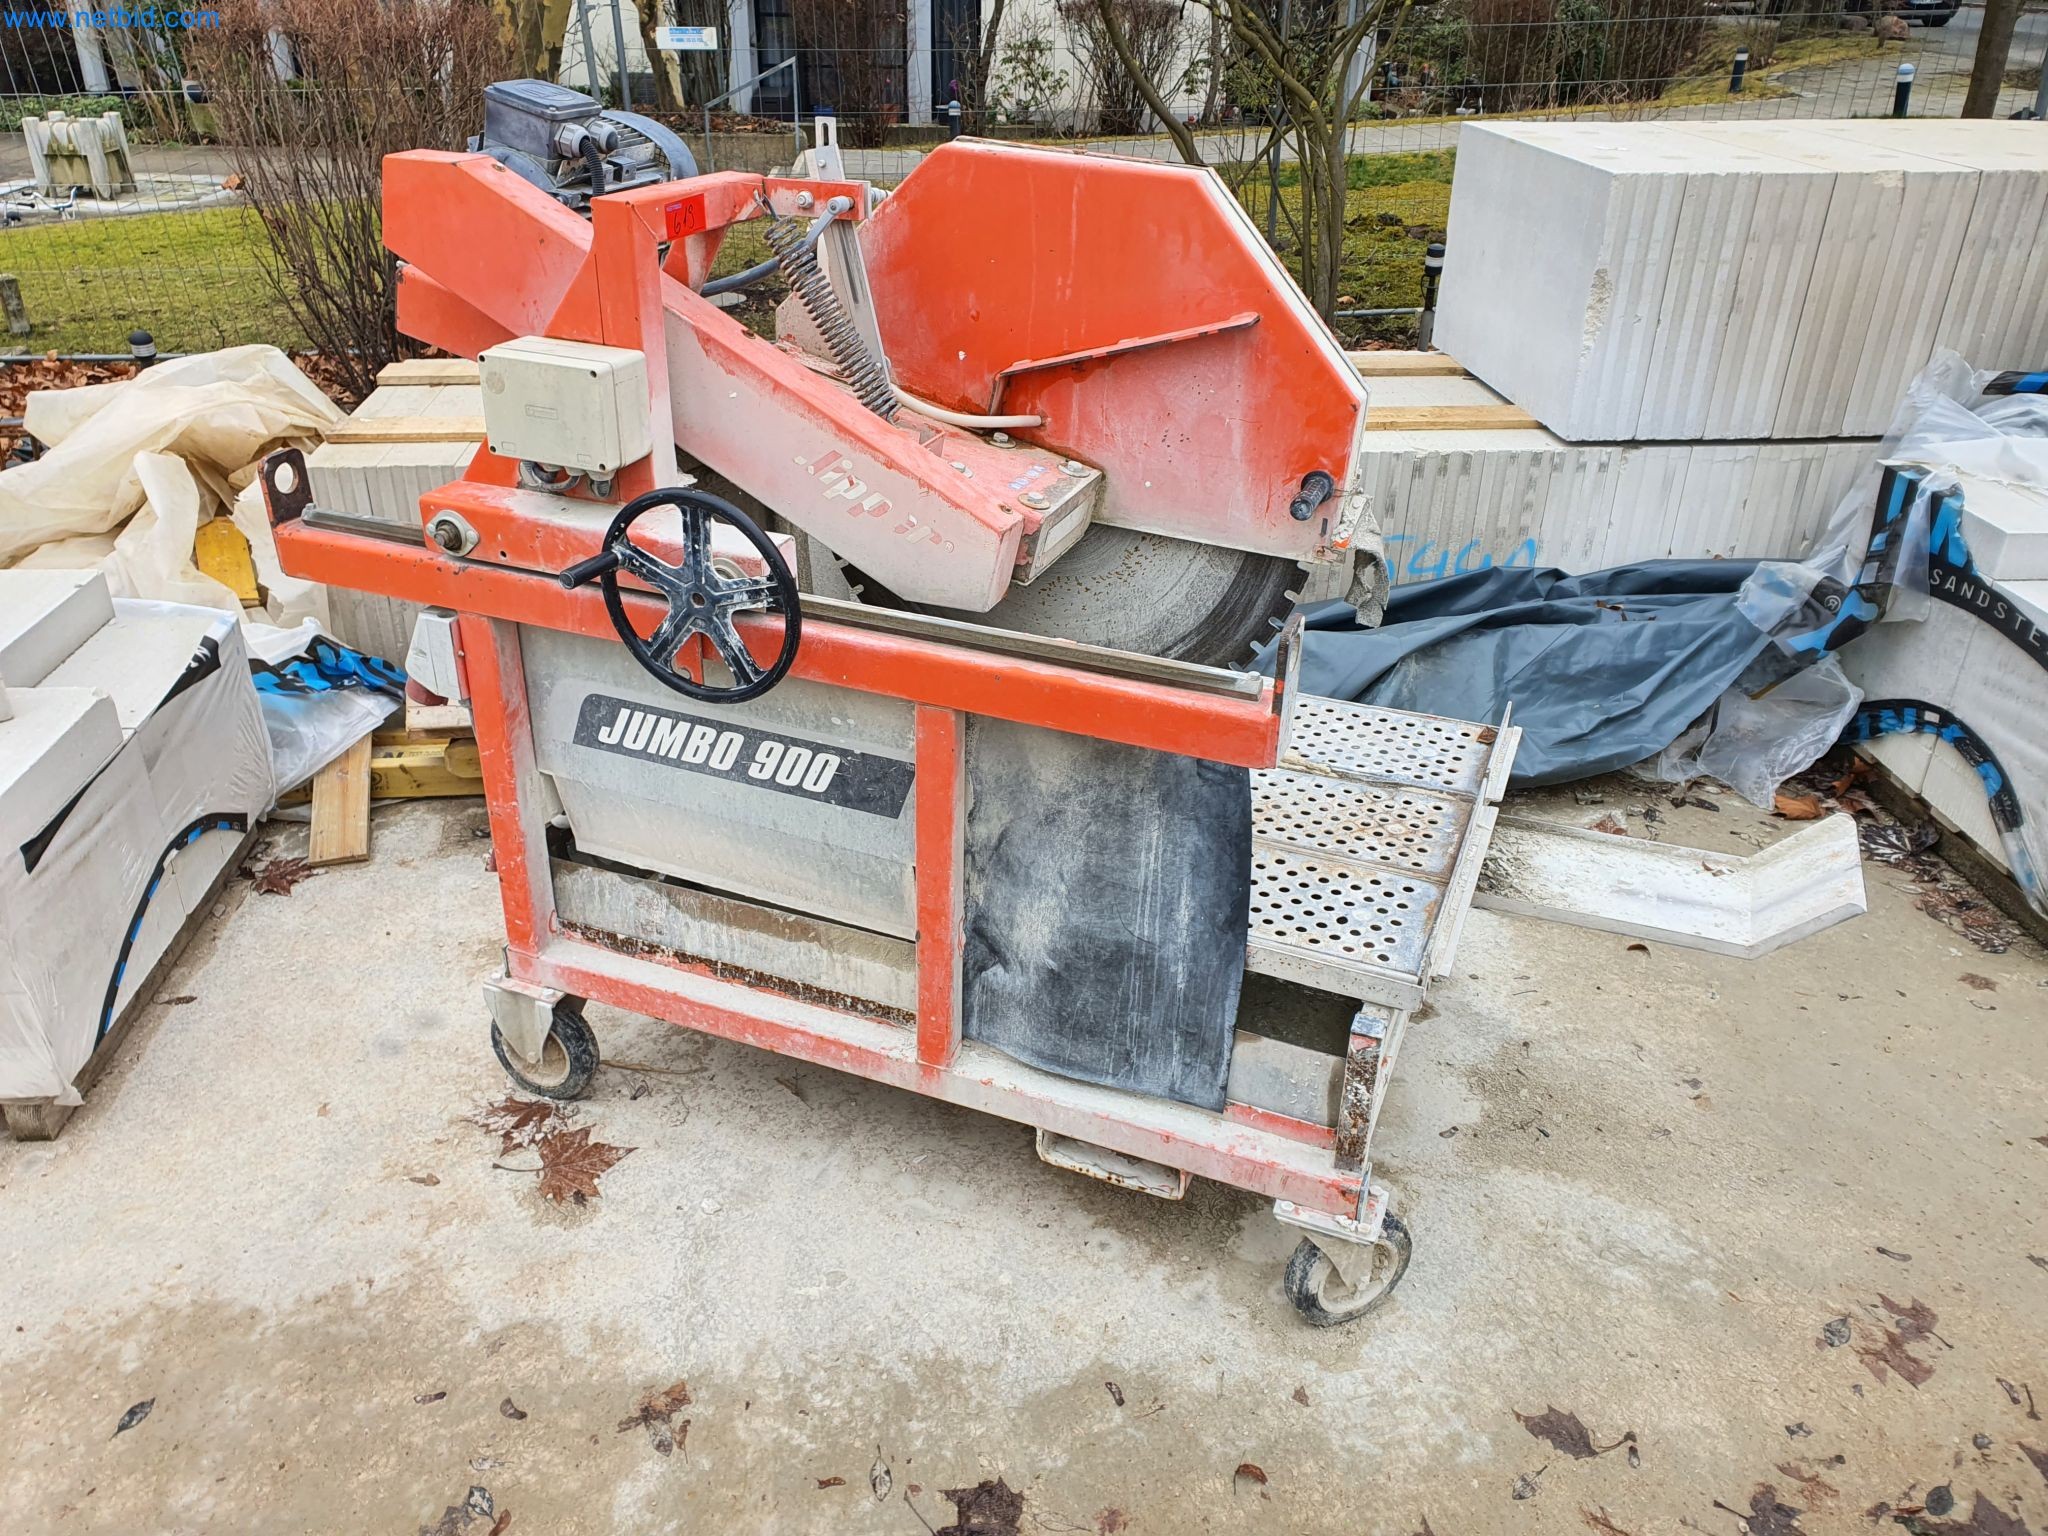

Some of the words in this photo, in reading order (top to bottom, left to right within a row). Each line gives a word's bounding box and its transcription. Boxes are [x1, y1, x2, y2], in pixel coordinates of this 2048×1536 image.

[1929, 567, 2048, 658] SANDSTE
[598, 707, 745, 771] JUMBO
[747, 740, 841, 793] 900
